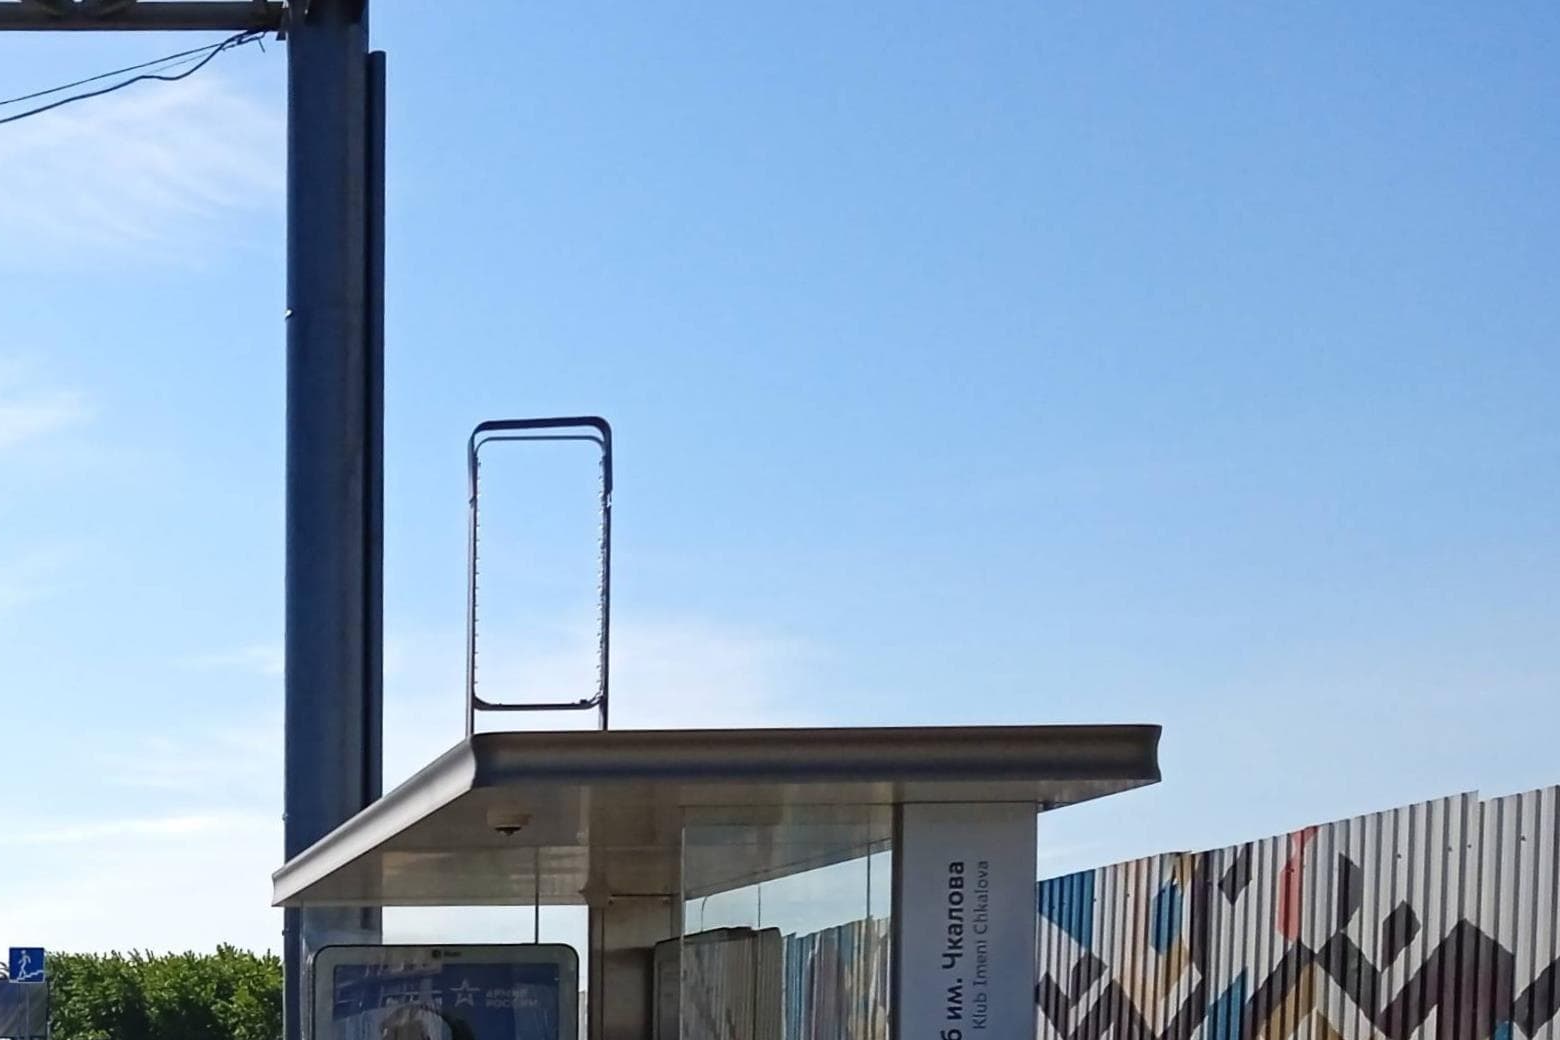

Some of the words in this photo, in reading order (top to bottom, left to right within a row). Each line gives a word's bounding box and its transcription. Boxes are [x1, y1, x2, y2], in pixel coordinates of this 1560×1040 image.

[942, 861, 966, 969] Чкалова
[972, 860, 989, 935] Chkalova
[972, 940, 988, 985] Imeni
[946, 977, 964, 1026] им.
[972, 993, 987, 1030] Klub
